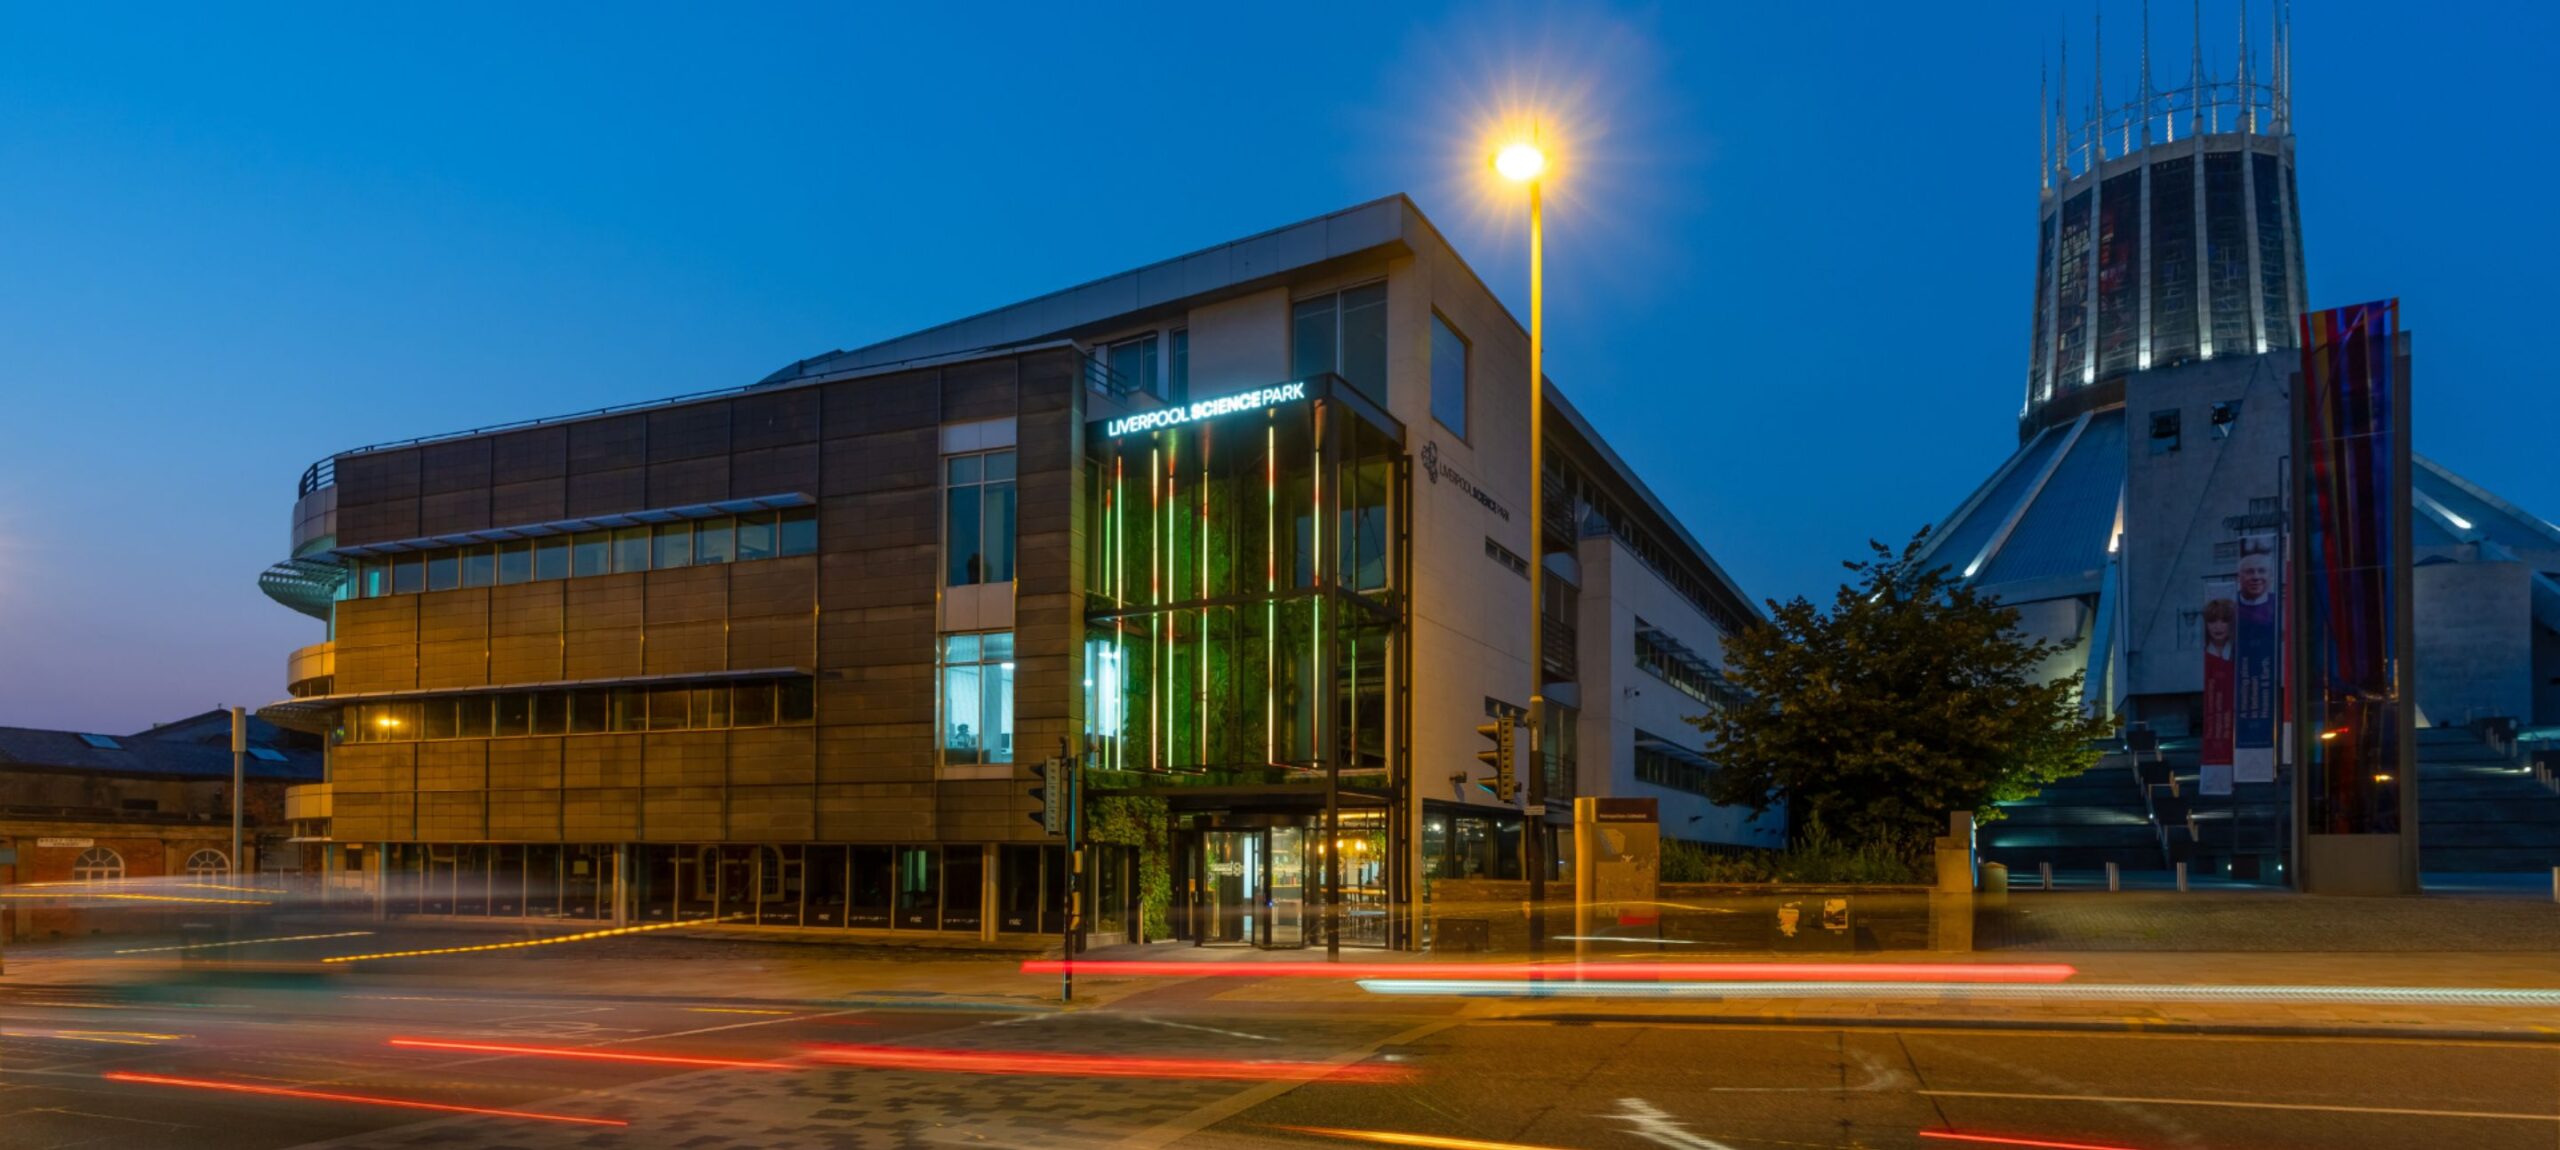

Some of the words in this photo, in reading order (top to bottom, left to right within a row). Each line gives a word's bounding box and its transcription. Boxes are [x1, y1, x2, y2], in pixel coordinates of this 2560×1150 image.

[1108, 406, 1190, 437] LIVERPOOL
[1191, 390, 1261, 420] SCIENCE
[1262, 382, 1305, 405] PARK
[1439, 462, 1473, 497] LIVERPOOL
